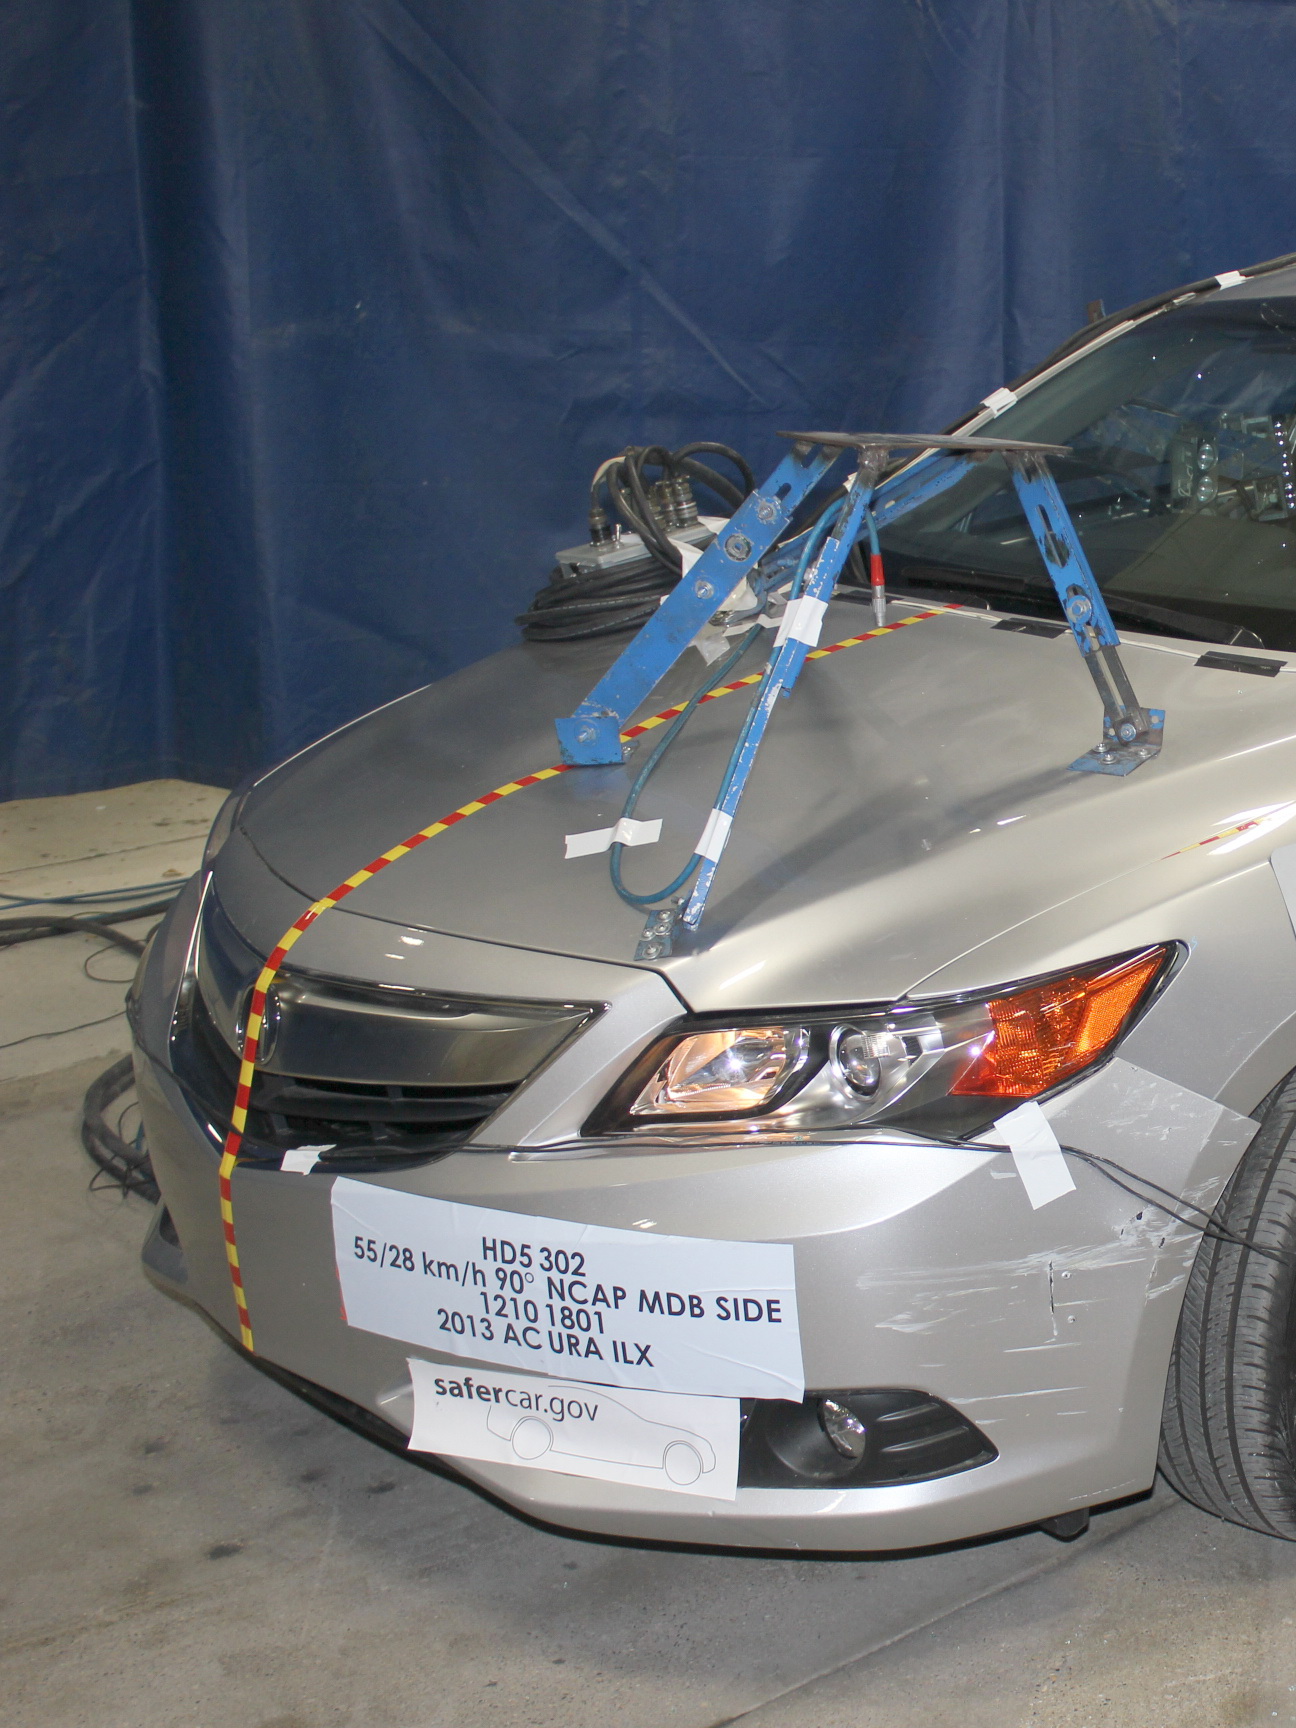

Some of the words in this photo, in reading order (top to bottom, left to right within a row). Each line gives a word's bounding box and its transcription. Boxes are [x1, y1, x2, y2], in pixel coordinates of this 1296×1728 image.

[353, 1235, 415, 1273] 55/28
[422, 1251, 487, 1289] km/h
[547, 1276, 627, 1310] NCAP
[639, 1291, 705, 1318] MDB
[717, 1297, 782, 1324] SIDE
[438, 1308, 495, 1342] 2013
[612, 1340, 655, 1368] ILX
[433, 1374, 599, 1422] safercar.gov
